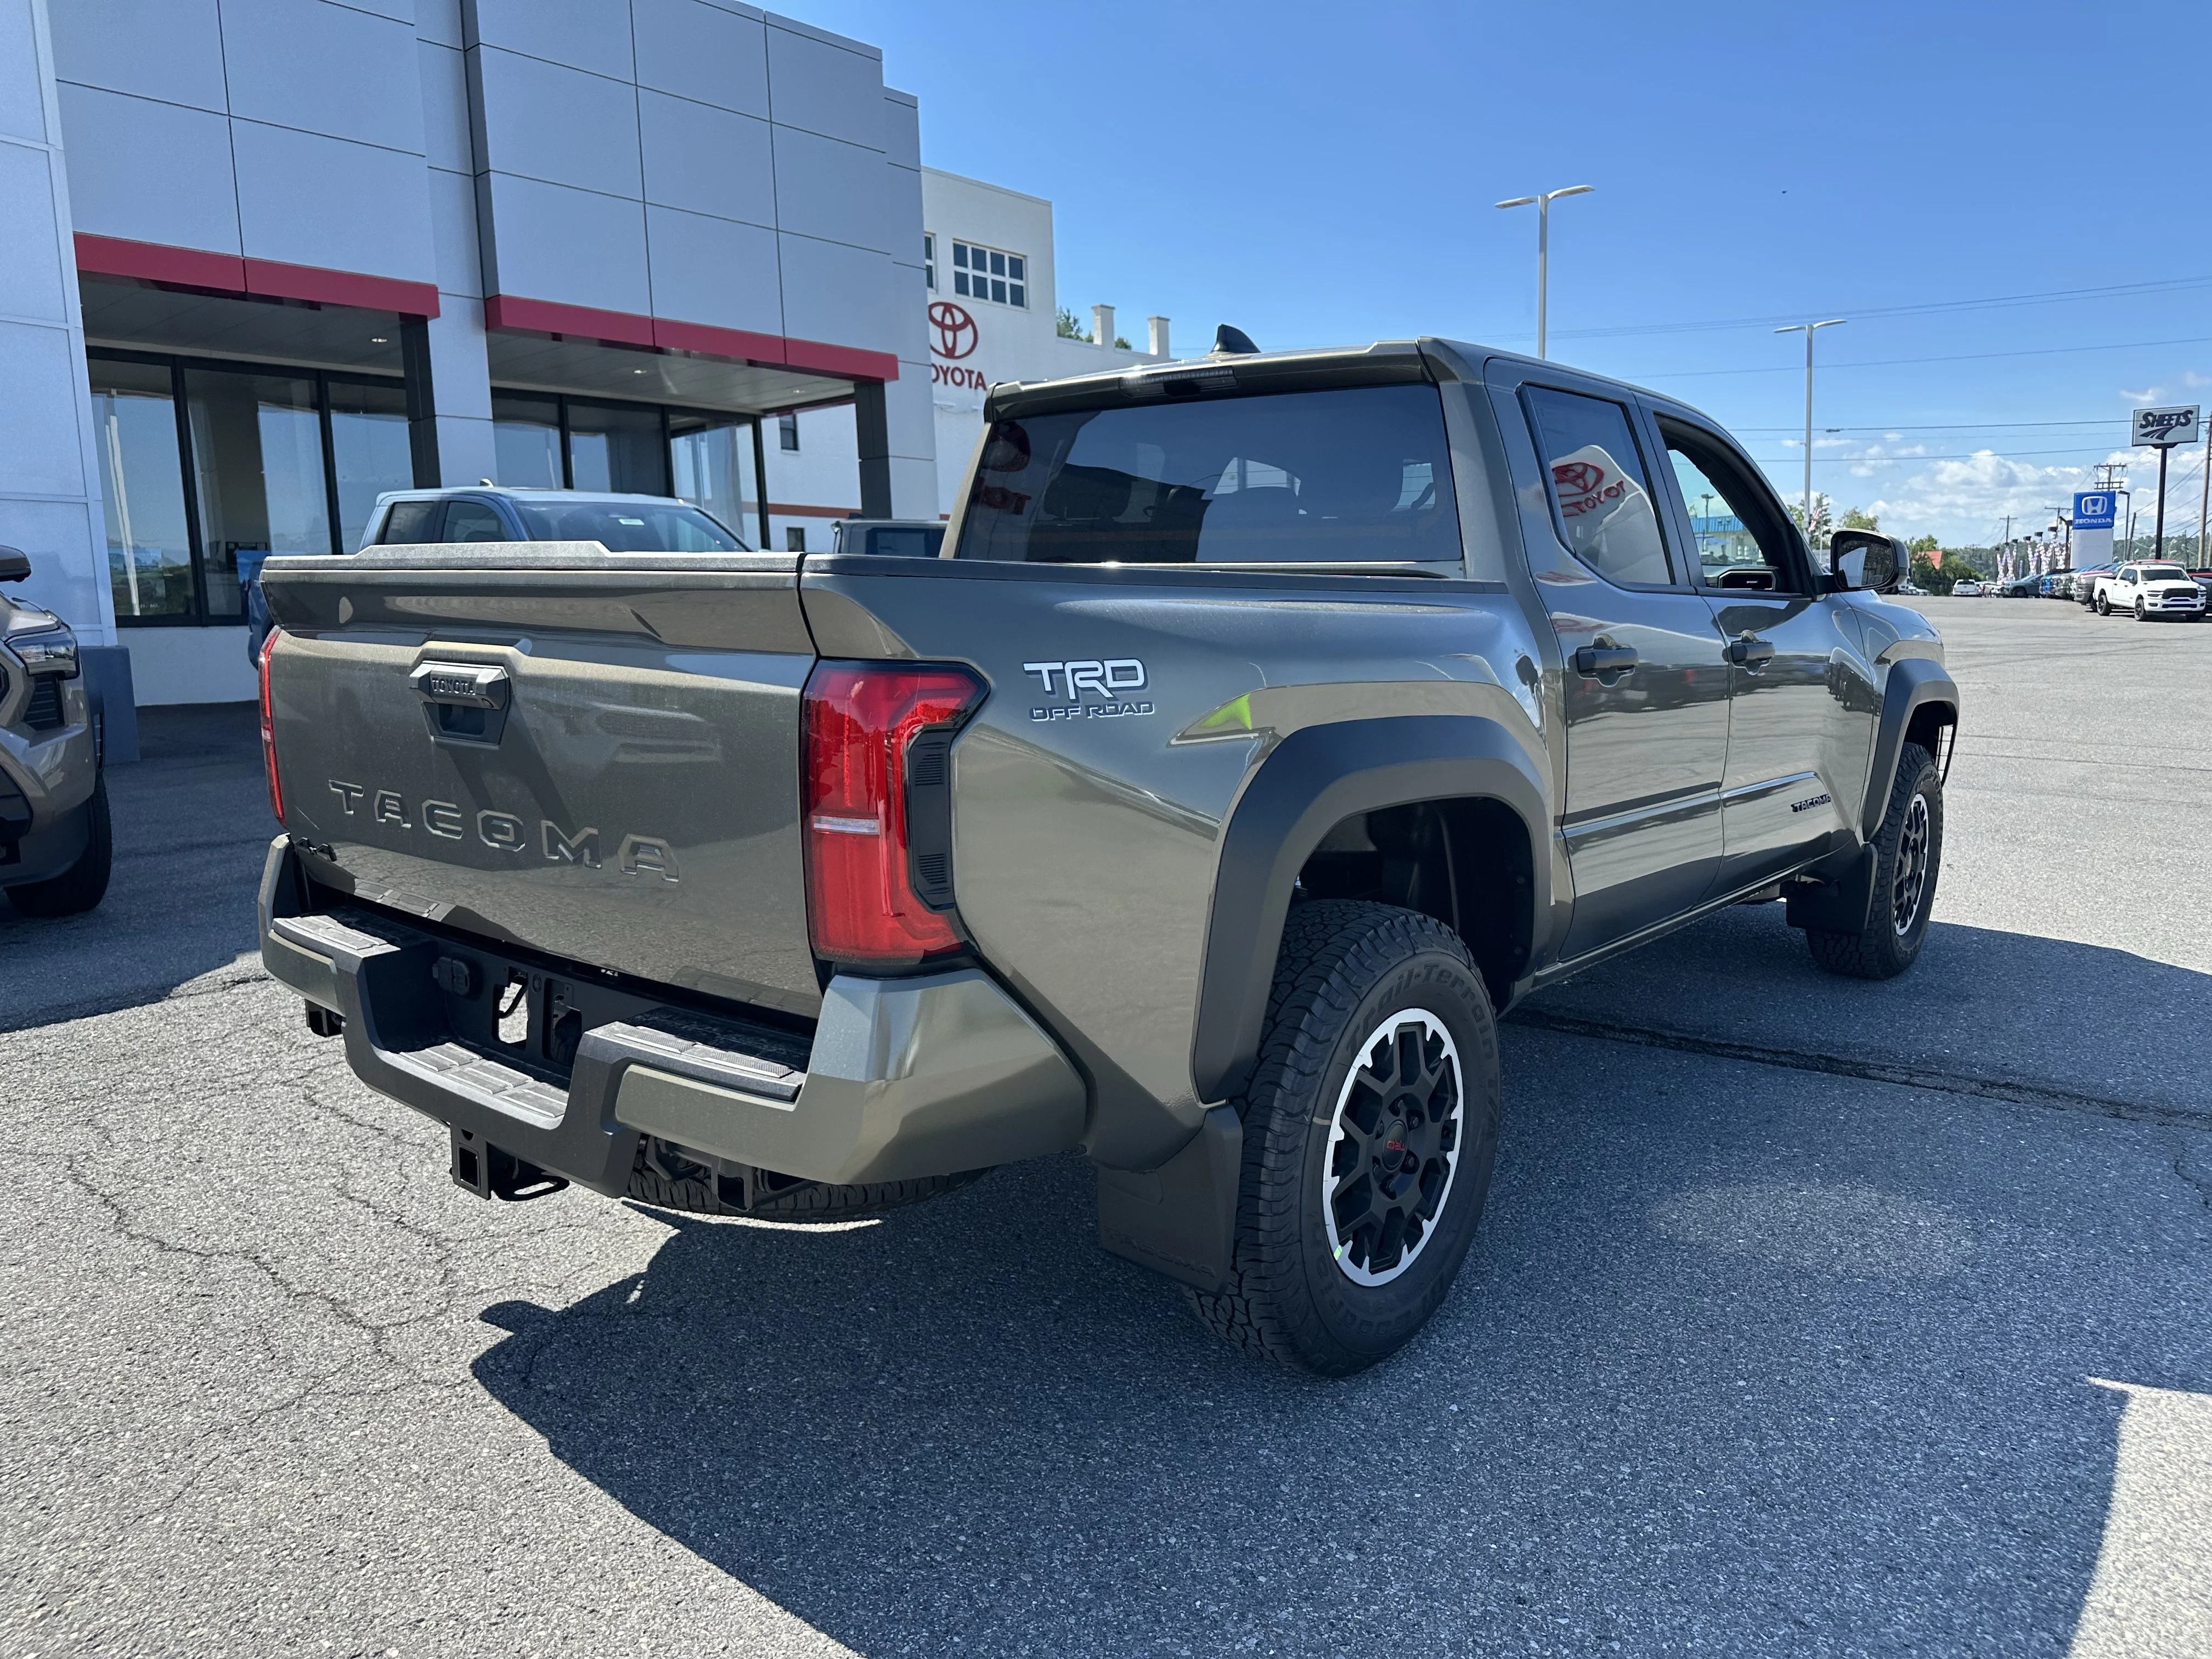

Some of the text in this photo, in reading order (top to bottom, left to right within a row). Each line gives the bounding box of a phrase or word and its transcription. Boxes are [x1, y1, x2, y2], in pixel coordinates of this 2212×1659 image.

[931, 363, 988, 391] OYOTA
[432, 676, 476, 696] TOYOTA
[1022, 658, 1149, 703] TRD
[1029, 701, 1155, 722] OFF ROAD
[1791, 793, 1831, 812] TACOMA
[328, 778, 679, 882] TACOMA
